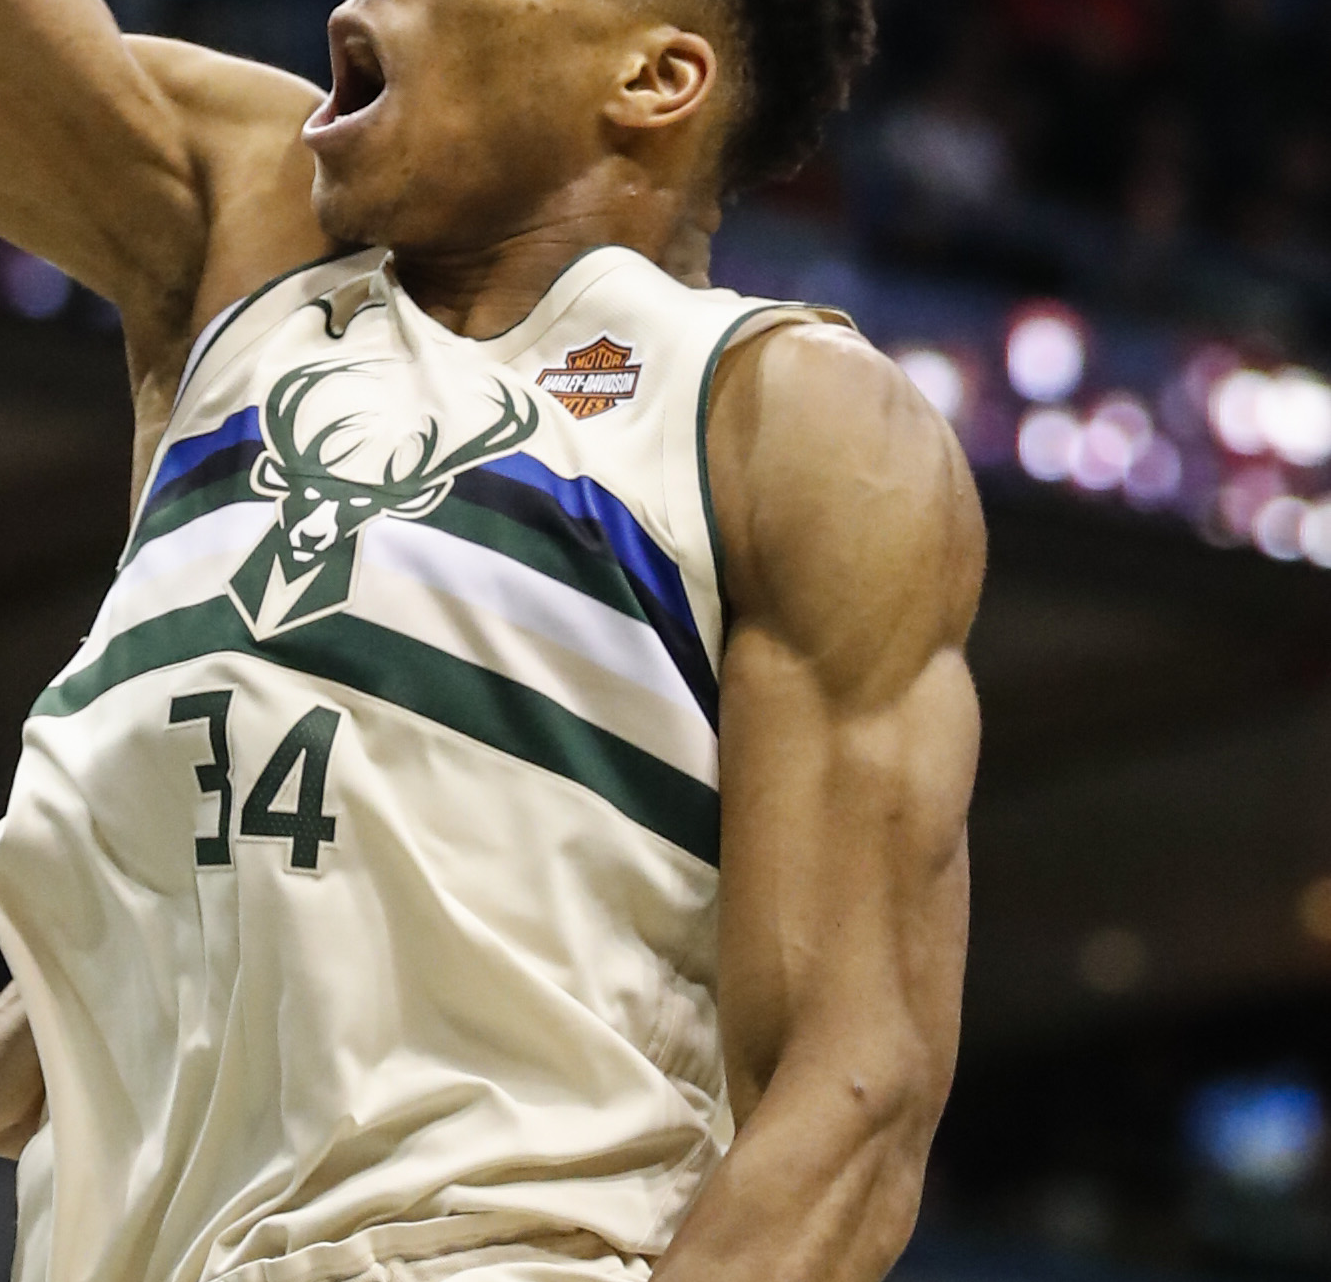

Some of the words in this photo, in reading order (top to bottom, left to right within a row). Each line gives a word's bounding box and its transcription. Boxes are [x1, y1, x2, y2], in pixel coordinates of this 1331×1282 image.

[574, 346, 622, 369] MOTOR
[541, 372, 636, 393] HARLEY-DAVIDSON
[169, 690, 341, 868] 34
